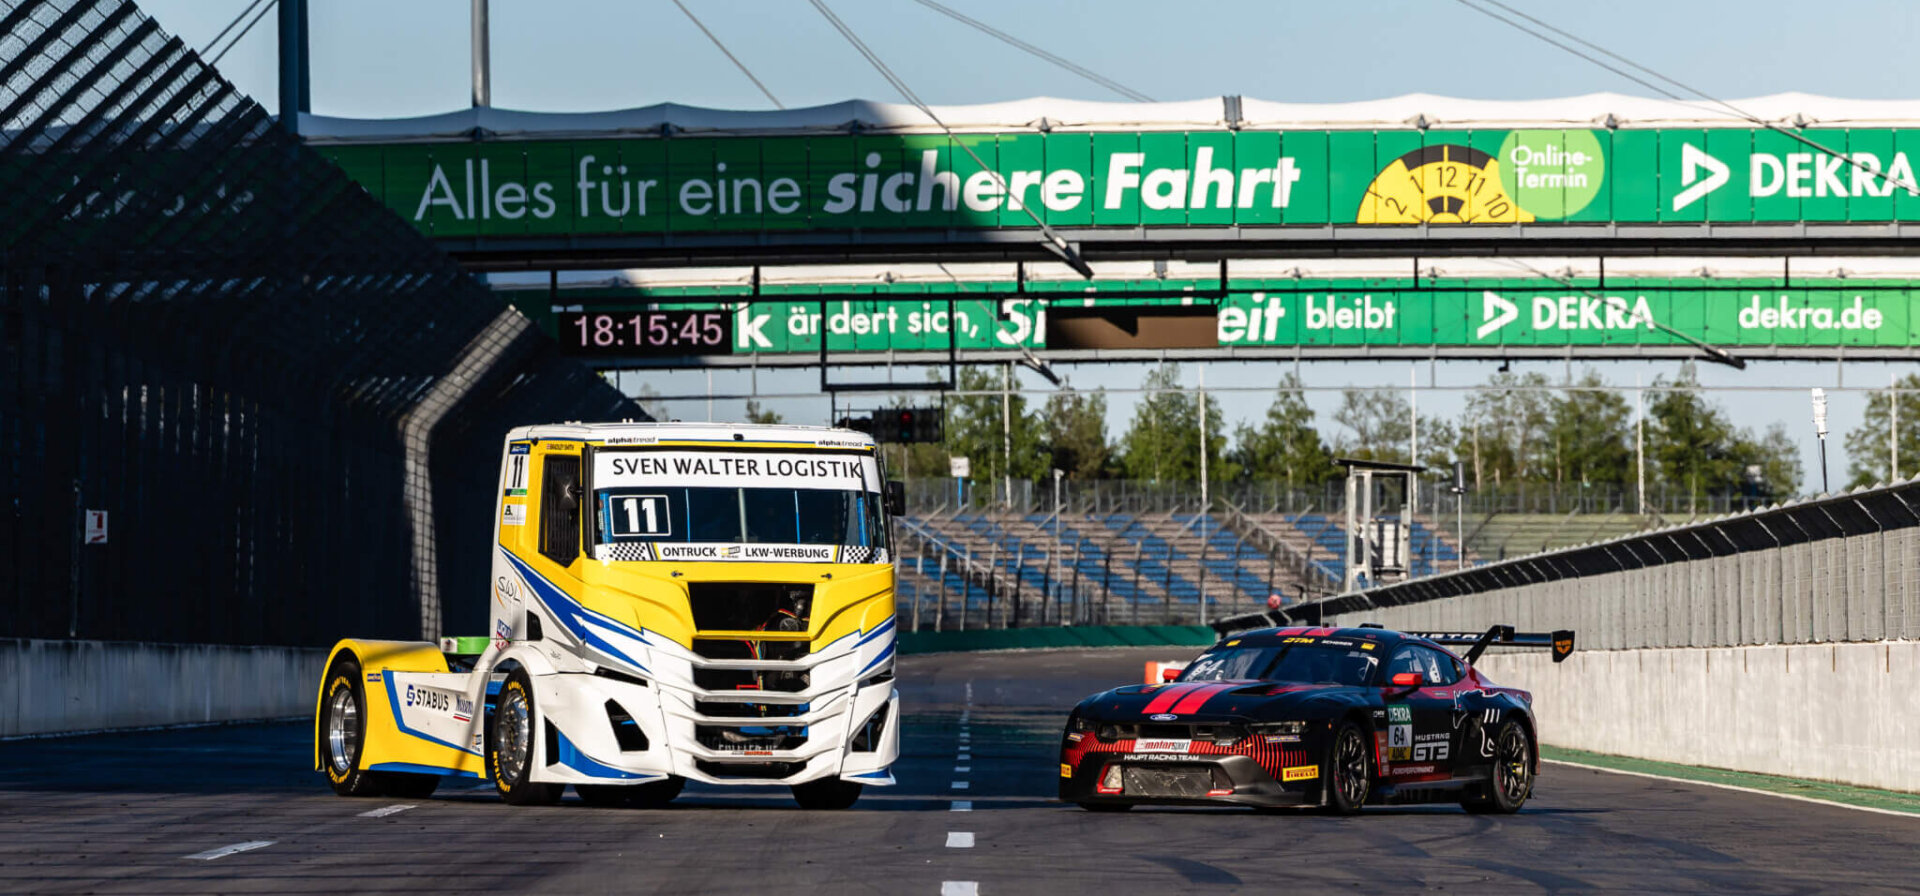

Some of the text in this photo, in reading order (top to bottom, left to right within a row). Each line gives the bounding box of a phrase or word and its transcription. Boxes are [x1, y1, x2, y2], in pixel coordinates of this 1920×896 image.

[1510, 145, 1593, 169] Online-
[414, 147, 1301, 222] Alles für eine sichere Fahrt
[1514, 168, 1589, 190] Termin
[1750, 151, 1920, 198] DEKRA
[1436, 166, 1458, 188] 12
[1464, 172, 1487, 197] 11
[1484, 193, 1510, 219] 10
[1305, 291, 1396, 331] bleibt
[1531, 296, 1655, 331] DEKRA
[1738, 295, 1883, 331] dekra.de
[573, 313, 724, 347] 18:15:45
[512, 455, 524, 488] 11
[613, 458, 863, 479] SVEN WALTER LOGISTIK
[622, 498, 659, 533] 11
[662, 546, 717, 557] ONTRUCK
[745, 548, 829, 559] LKW-WERBUNG
[415, 688, 449, 712] STABUS
[1388, 707, 1411, 722] DEKRA
[1394, 726, 1405, 746] 64
[1415, 733, 1451, 741] MUSTANG
[1414, 741, 1449, 761] GT3
